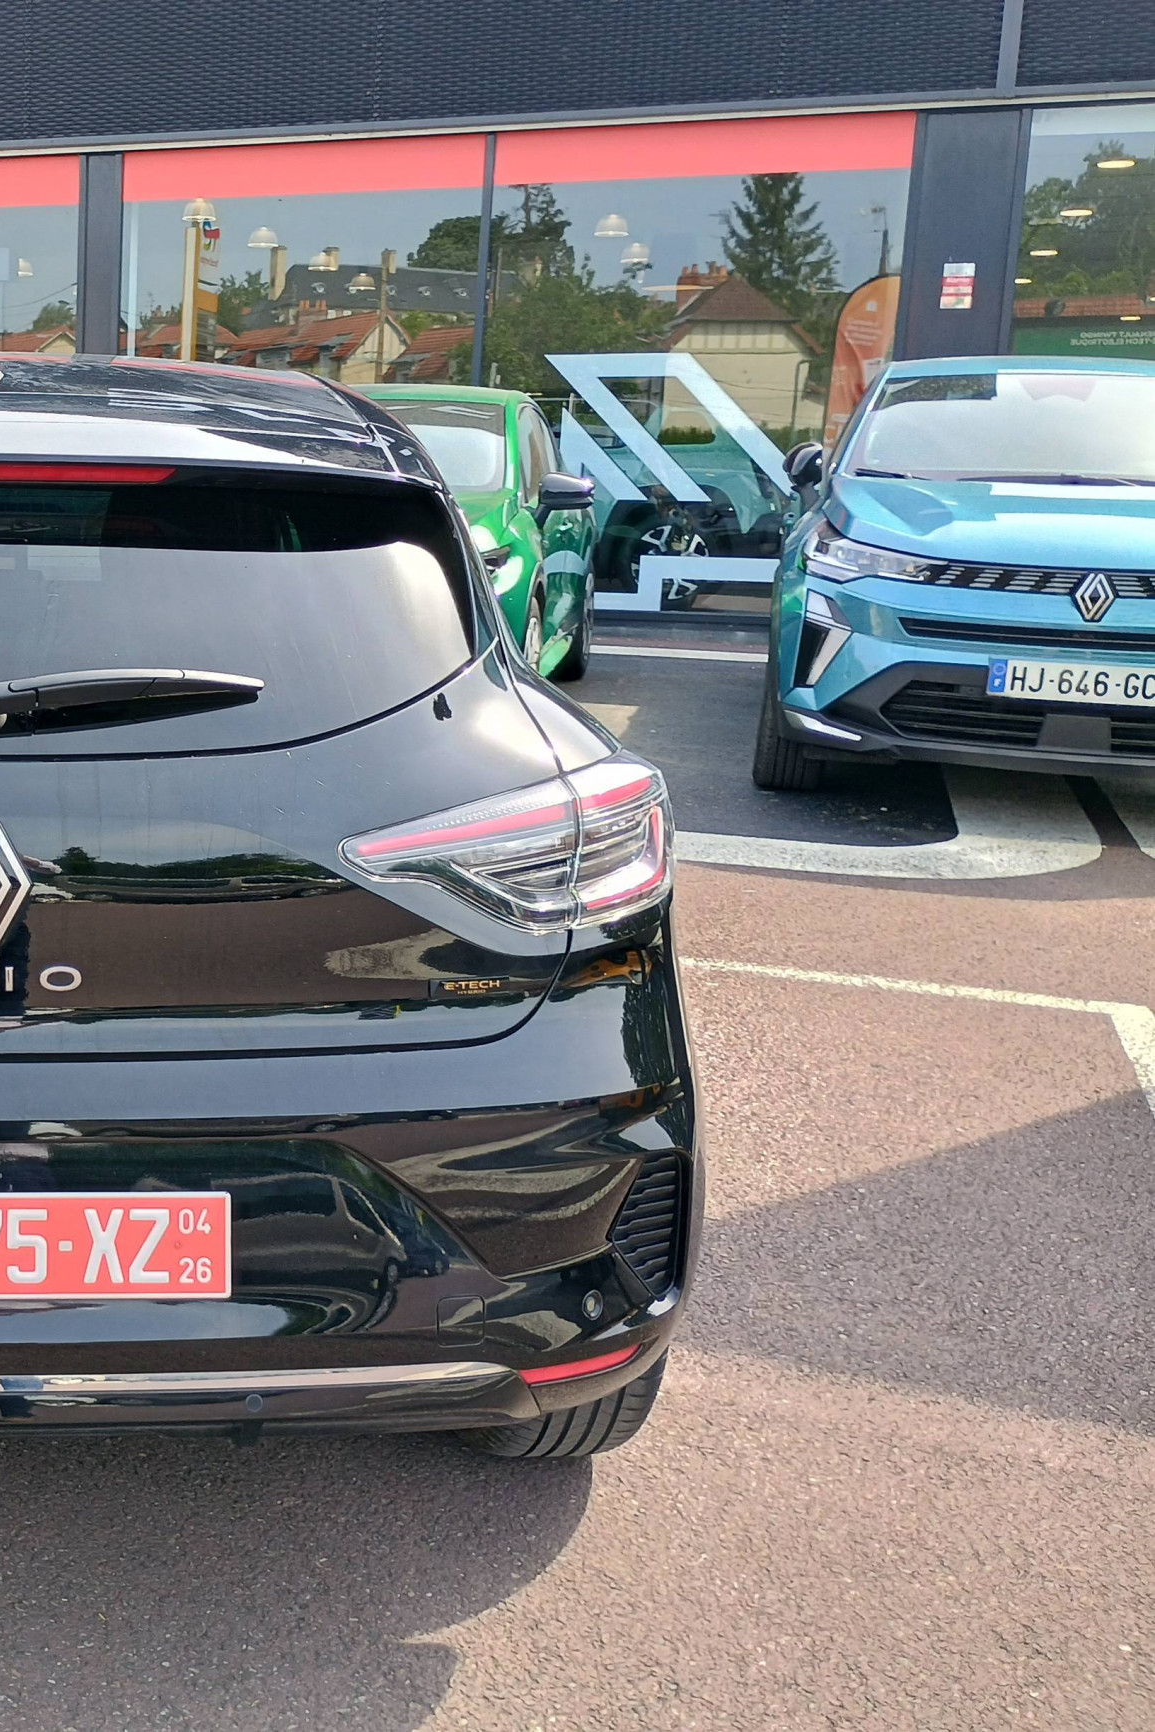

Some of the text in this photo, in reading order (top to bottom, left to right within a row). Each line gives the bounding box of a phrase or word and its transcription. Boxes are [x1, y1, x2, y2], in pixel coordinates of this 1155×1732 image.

[443, 980, 501, 990] E-TECH
[178, 1208, 212, 1235] 04
[178, 1256, 213, 1285] 26
